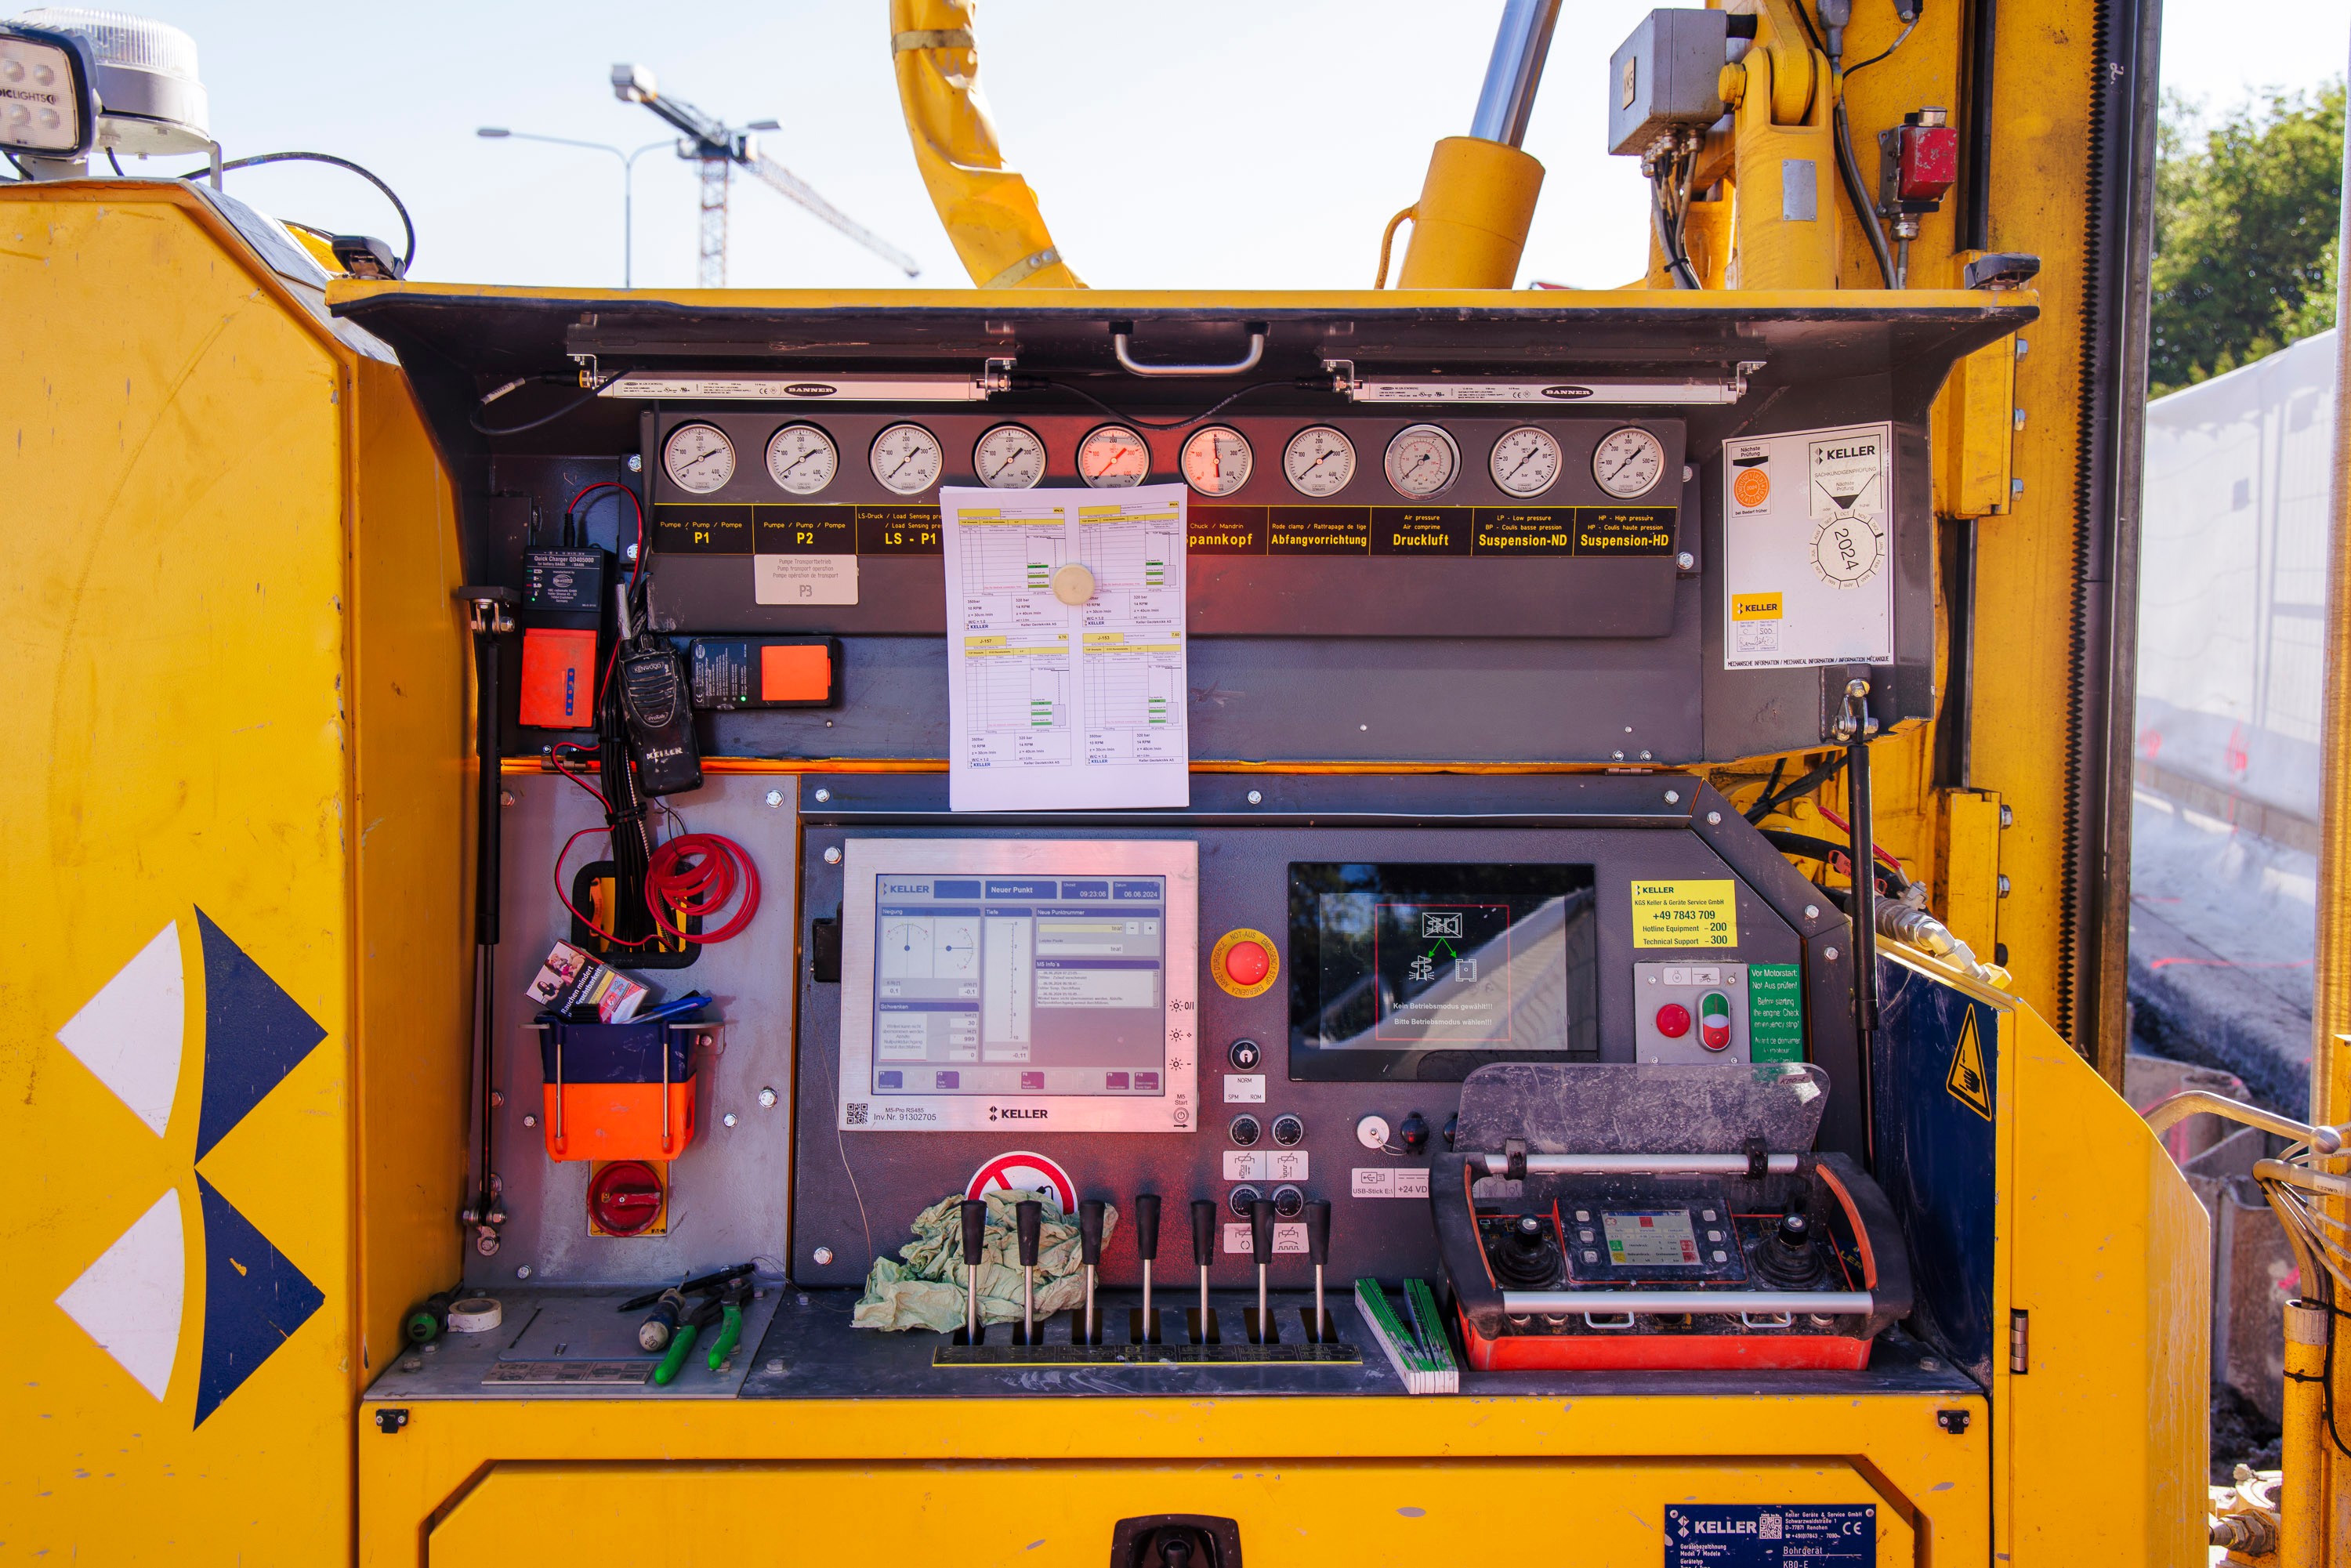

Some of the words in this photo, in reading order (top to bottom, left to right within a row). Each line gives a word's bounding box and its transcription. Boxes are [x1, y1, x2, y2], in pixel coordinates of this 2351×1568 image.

[1827, 445, 1875, 460] KELLER
[694, 532, 709, 544] P1
[797, 533, 813, 545] P2
[885, 533, 902, 545] LS
[922, 533, 936, 545] P1
[1271, 534, 1367, 547] Abfangvorrichtung
[1393, 534, 1449, 546] Druckluft
[1479, 534, 1567, 549] Suspension-ND
[1581, 534, 1668, 549] Suspension-HD
[1835, 528, 1859, 570] 2024
[799, 585, 813, 597] P3
[1745, 603, 1777, 612] KELLER
[634, 663, 661, 673] KENWOOD
[1653, 911, 1671, 920] +49
[1675, 911, 1696, 920] 7843
[1699, 911, 1715, 919] 709
[1666, 925, 1699, 933] Equipment
[1261, 939, 1277, 970] EMERGENCY
[1266, 970, 1276, 985] STOP
[561, 989, 580, 1015] Rauchen
[577, 966, 594, 990] mindert
[1231, 984, 1264, 996] EMERGENZA
[1765, 981, 1776, 990] Aus
[1777, 981, 1798, 990] prüfen!
[1461, 1002, 1493, 1011] gewählt!!!
[1783, 1009, 1799, 1017] Check
[1002, 1110, 1049, 1119] KELLER
[1694, 1521, 1757, 1534] KELLER
[1783, 1546, 1823, 1556] Bohrgerät
